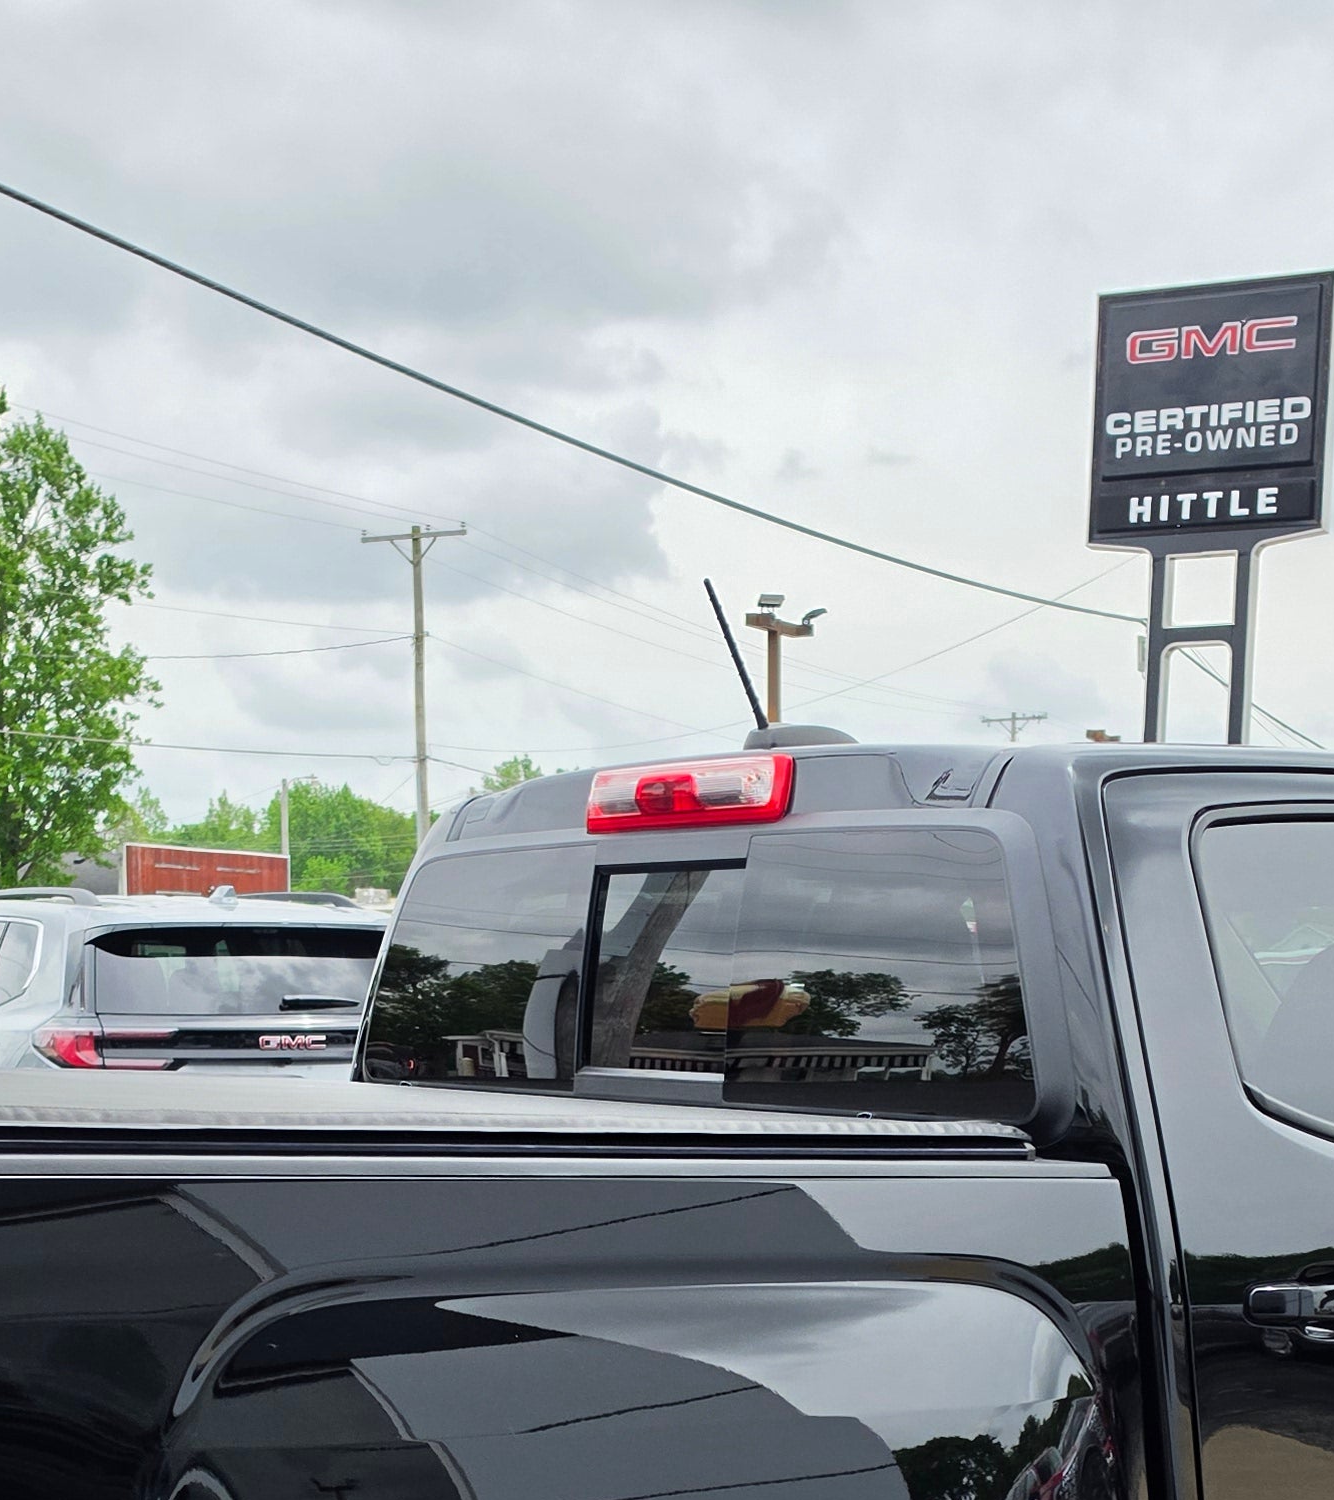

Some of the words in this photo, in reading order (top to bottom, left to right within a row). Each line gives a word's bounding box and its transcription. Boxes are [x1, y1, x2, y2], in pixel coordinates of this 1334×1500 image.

[1127, 316, 1297, 364] GMC
[1106, 397, 1311, 435] CERTIFIED
[1116, 423, 1298, 458] PRE-OWNED
[1129, 488, 1278, 523] HITTLE
[259, 1035, 327, 1050] GMC
